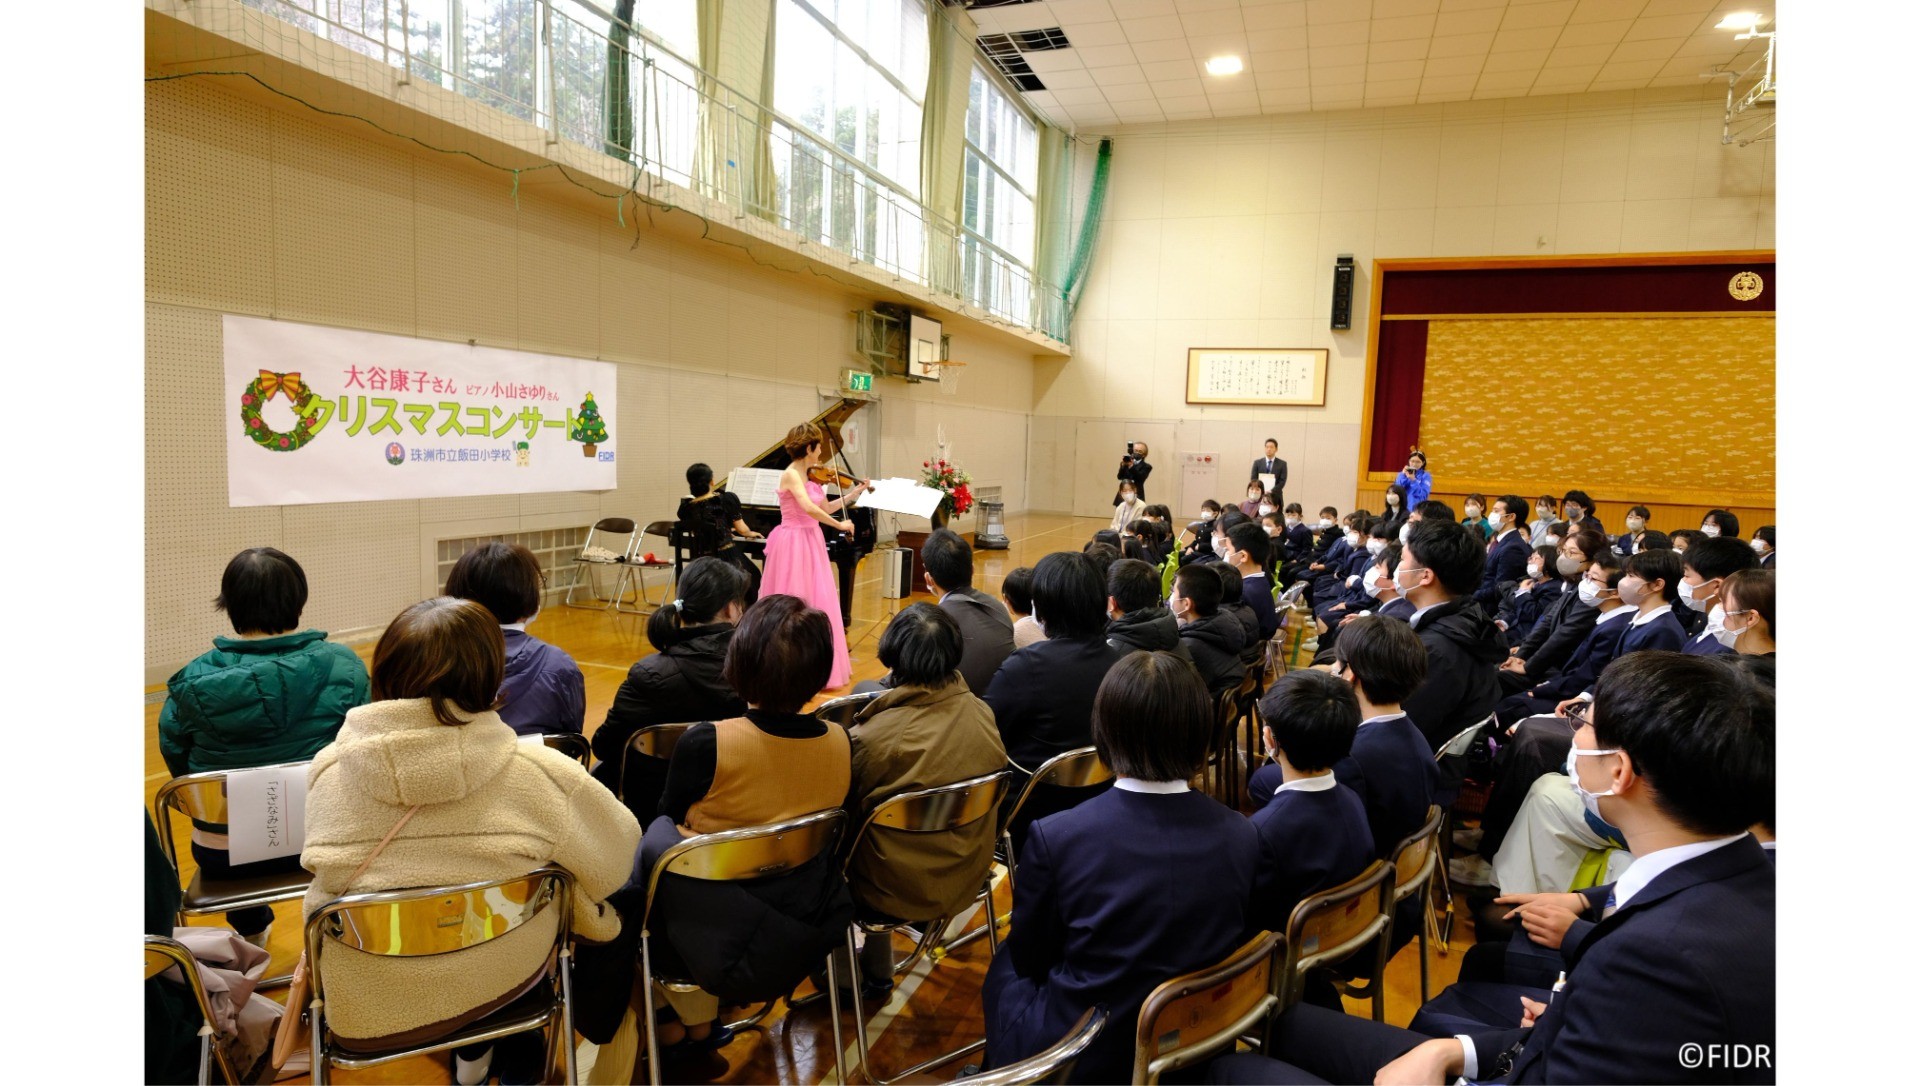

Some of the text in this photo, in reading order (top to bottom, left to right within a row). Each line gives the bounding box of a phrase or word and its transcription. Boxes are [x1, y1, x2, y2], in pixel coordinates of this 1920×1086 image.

[343, 364, 457, 394] 大谷康子さん
[301, 393, 583, 441] クリスマスコンサート
